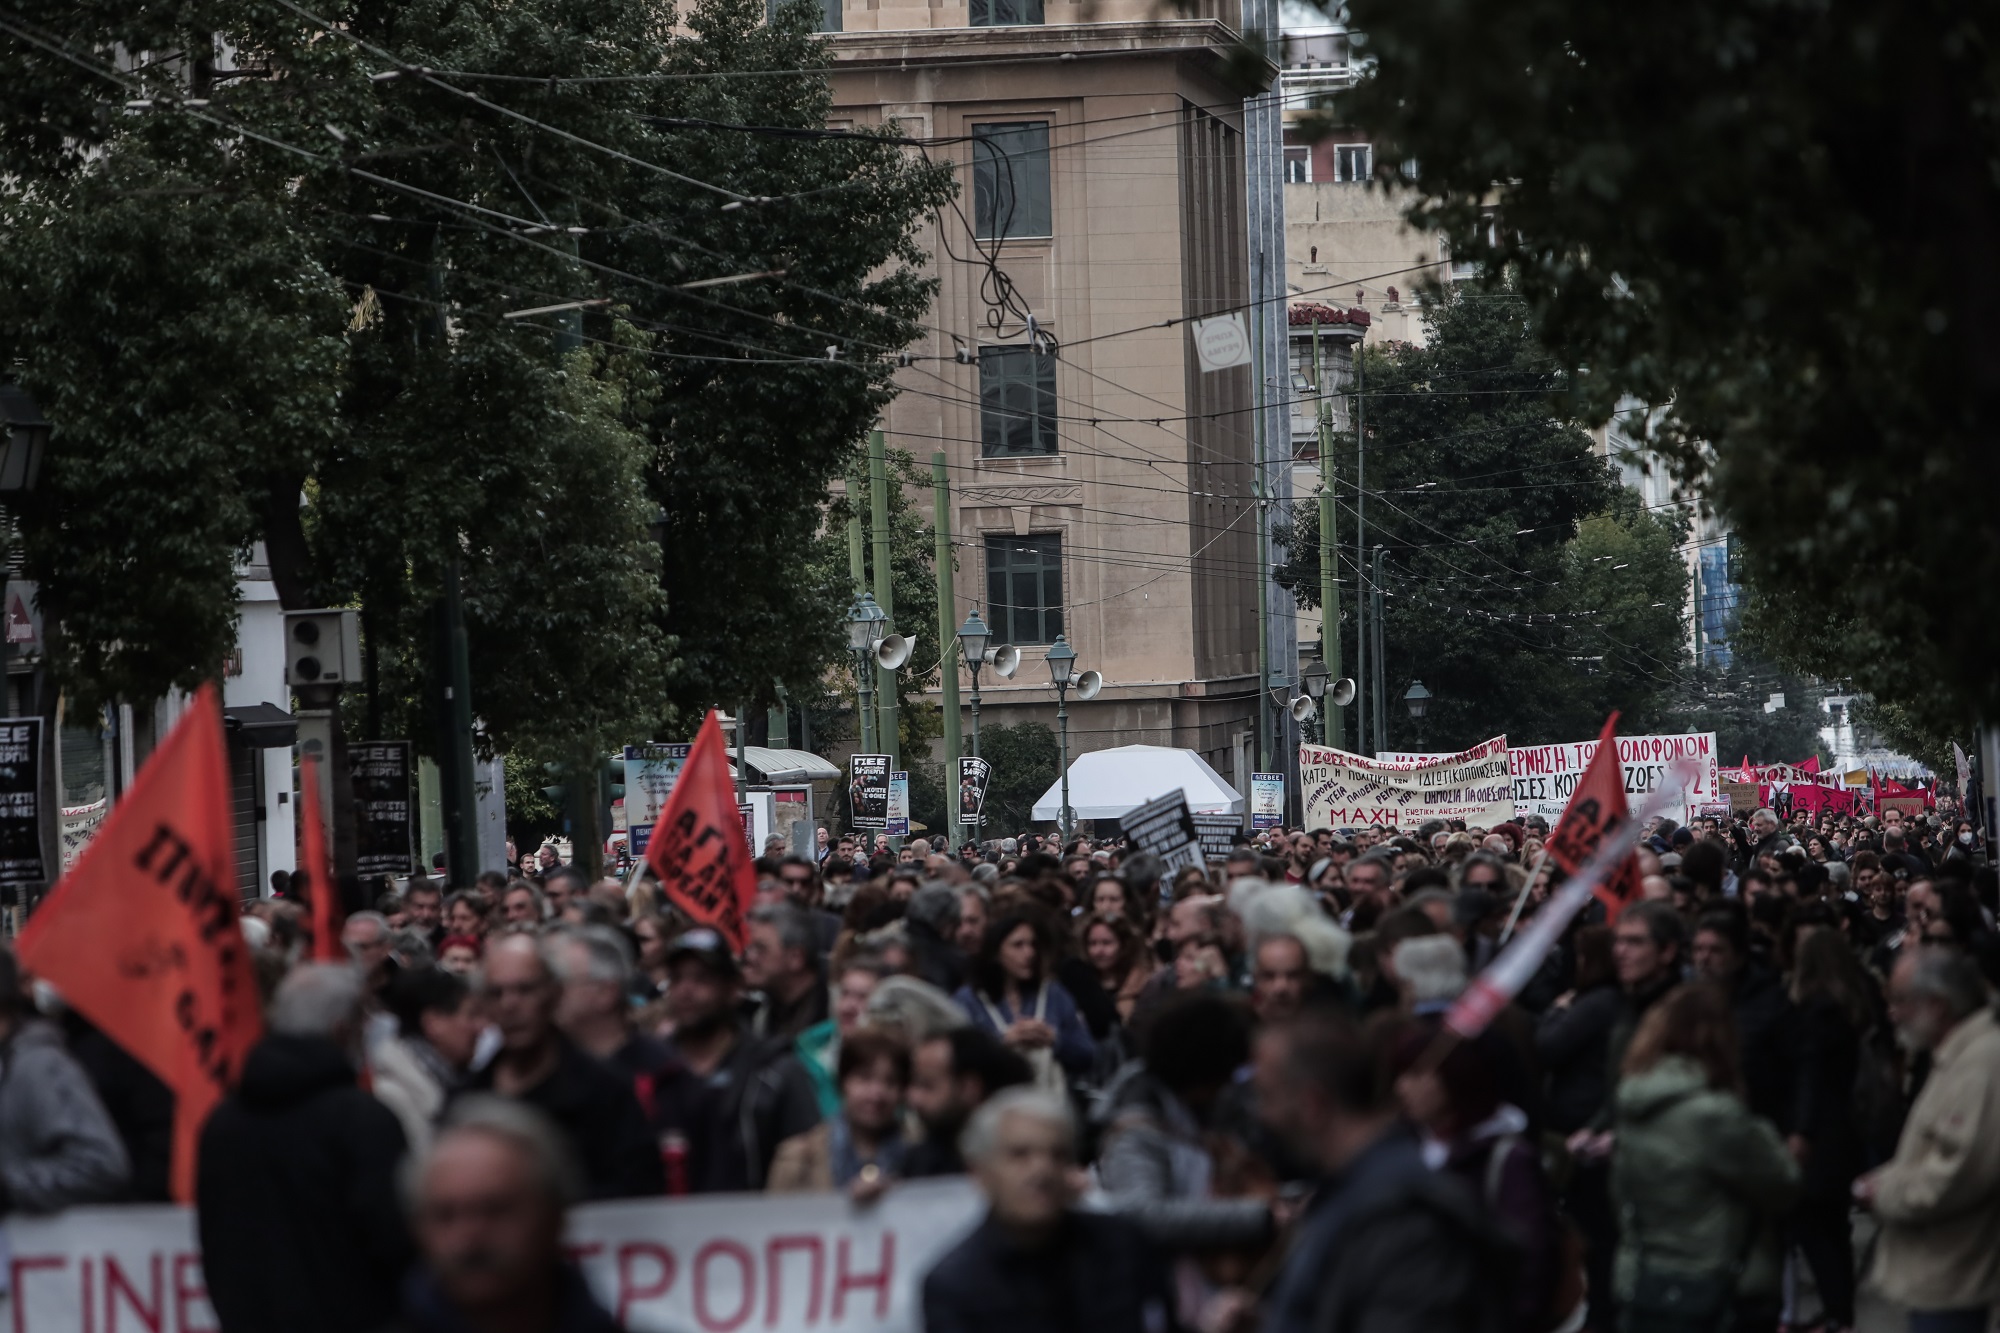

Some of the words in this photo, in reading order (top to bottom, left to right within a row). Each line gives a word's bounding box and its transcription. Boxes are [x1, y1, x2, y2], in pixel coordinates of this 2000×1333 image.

[1313, 751, 1347, 767] ΖΩΕΣ
[1348, 756, 1373, 769] ΜΑΣ
[1488, 737, 1507, 754] ΤΟΥΣ
[1616, 736, 1709, 762] ΟΛΟΦΟΝΩΝ
[854, 757, 886, 766] ΓΣΕΕ
[1302, 767, 1327, 786] ΚΑΤΩ
[1335, 768, 1341, 778] Η
[1348, 770, 1389, 786] ΠΟΛΙΤΙΚΗ
[1419, 760, 1508, 786] ΙΔΙΩΤΙΚΟΠΟΙΗΣΕΩΝ
[1307, 778, 1339, 813] ΜΕΤΑΦΟΡΕΣ
[1324, 786, 1347, 806] ΥΓΕΙΑ
[1465, 787, 1476, 803] ΓΙΑ
[1330, 808, 1398, 825] ΜΑΧΗ
[1405, 808, 1434, 816] ΕΝΩΤΙΚΗ
[1438, 807, 1486, 815] ΑΝΕΞΑΡΤΗΤΗ
